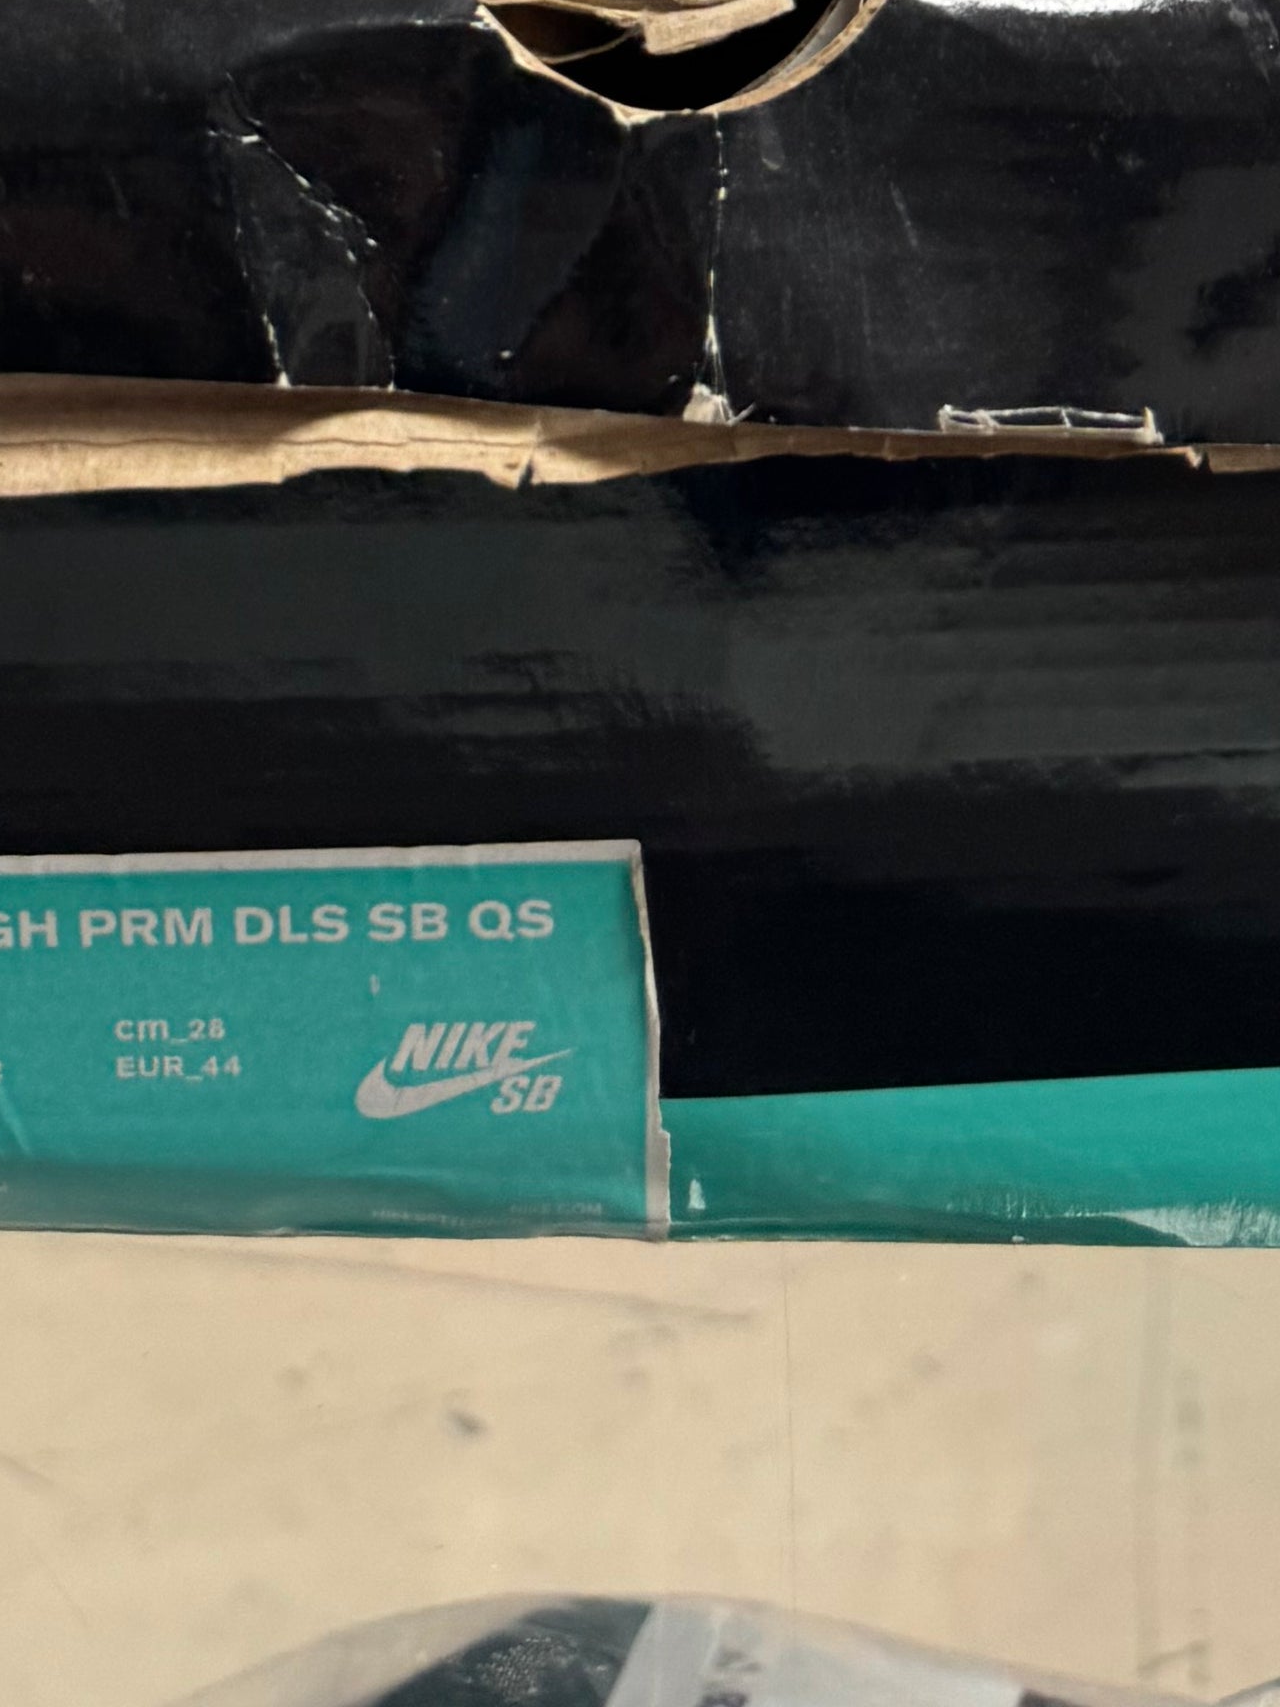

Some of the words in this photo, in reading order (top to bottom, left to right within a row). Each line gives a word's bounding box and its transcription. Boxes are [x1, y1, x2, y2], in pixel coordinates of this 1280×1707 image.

[79, 907, 215, 948] PRM
[234, 904, 350, 944] DLS
[368, 902, 449, 942] SB
[469, 899, 555, 941] QS
[389, 1020, 536, 1073] NIKE
[489, 1074, 562, 1114] SB
